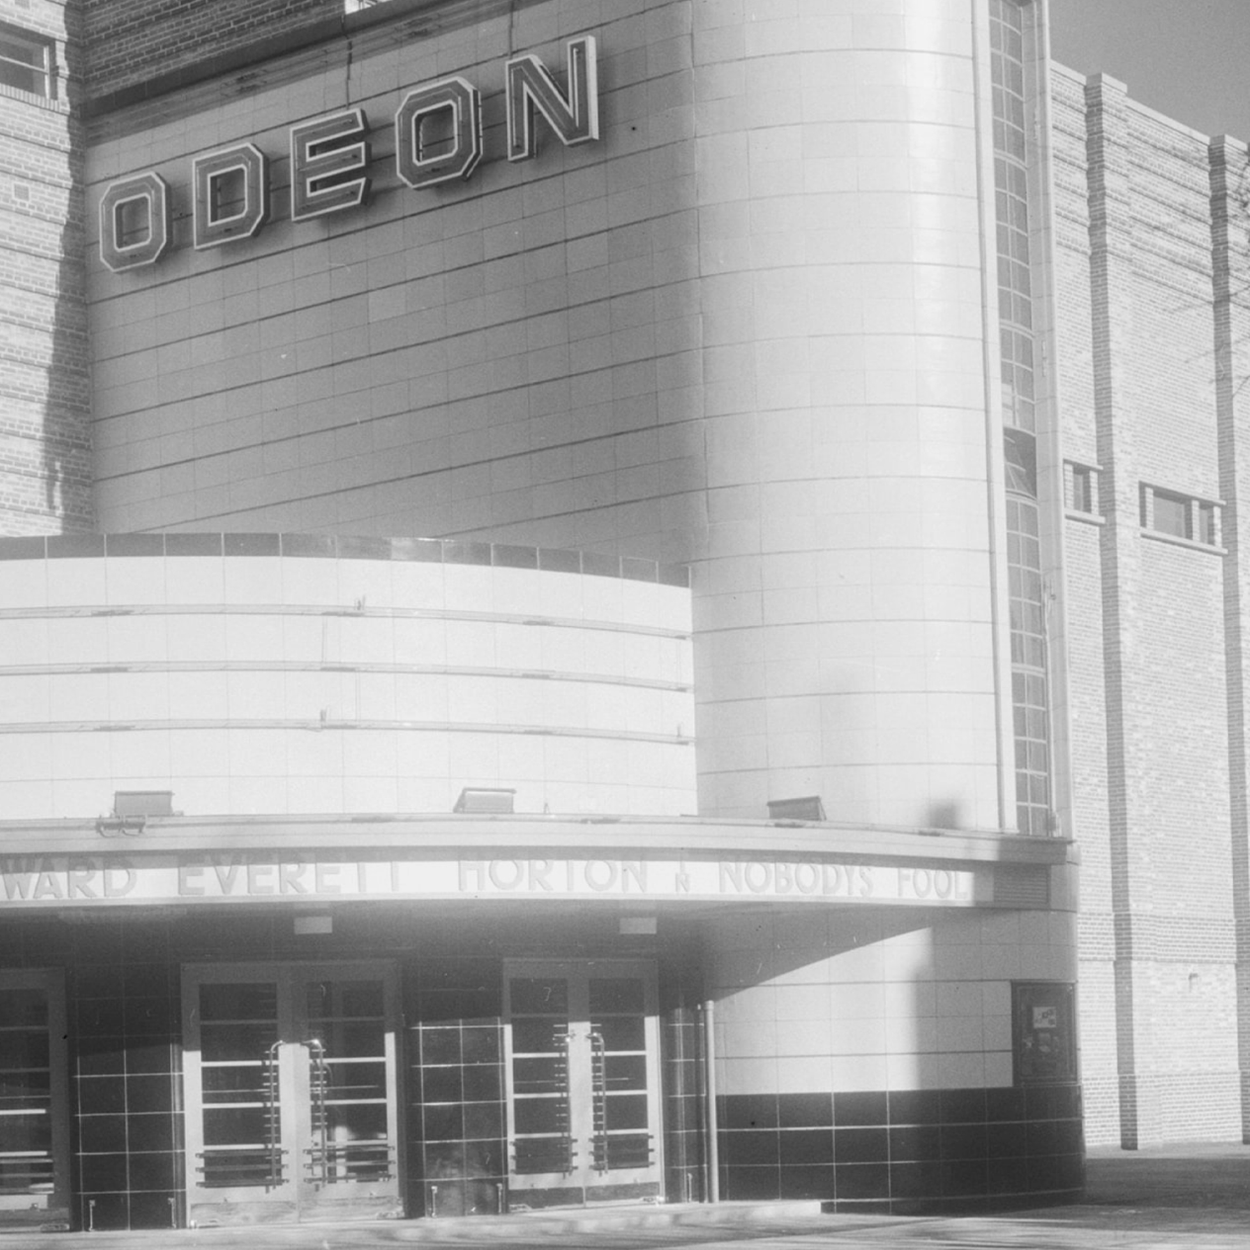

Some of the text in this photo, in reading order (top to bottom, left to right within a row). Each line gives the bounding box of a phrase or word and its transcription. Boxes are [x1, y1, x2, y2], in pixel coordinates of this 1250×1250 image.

[99, 34, 600, 274] ODEON
[457, 849, 648, 893] HORTON
[718, 853, 875, 899] NOBODYS
[897, 862, 969, 900] FOOL
